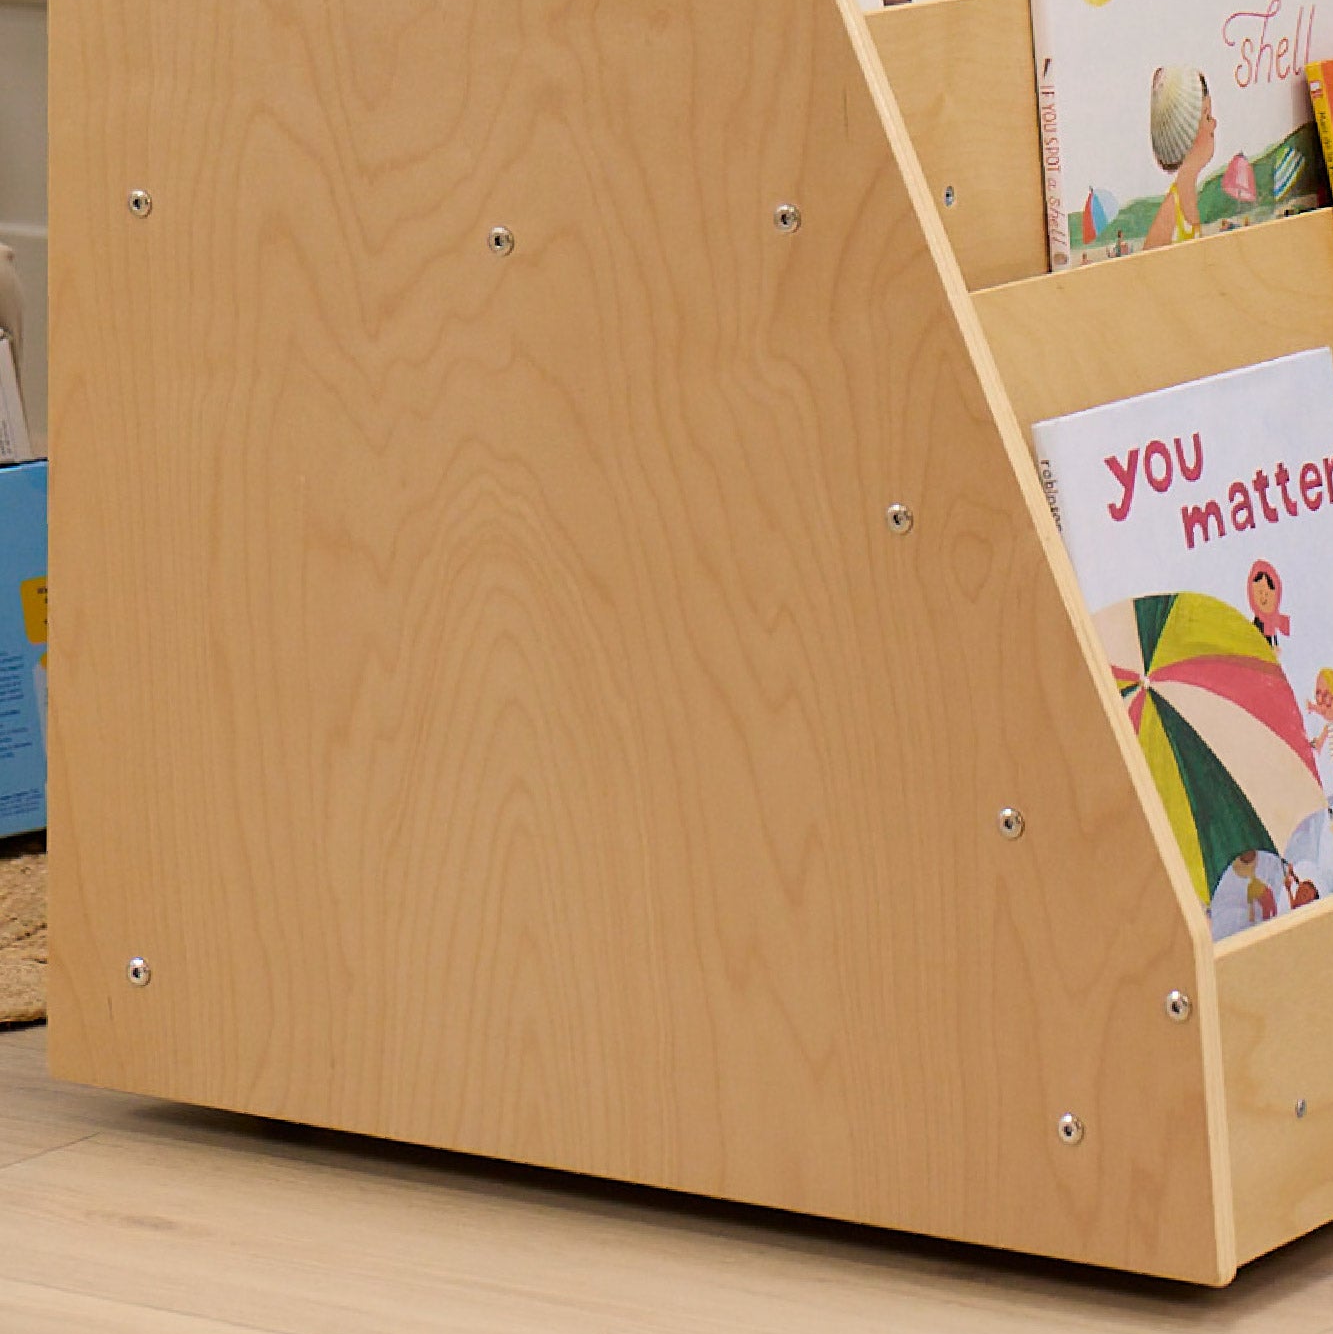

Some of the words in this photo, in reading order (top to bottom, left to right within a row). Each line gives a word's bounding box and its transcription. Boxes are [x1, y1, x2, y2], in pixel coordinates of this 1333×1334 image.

[1040, 85, 1055, 98] IF
[1041, 103, 1057, 134] YOU
[1043, 136, 1061, 173] SPOT
[1047, 177, 1057, 192] a
[1104, 432, 1203, 522] you
